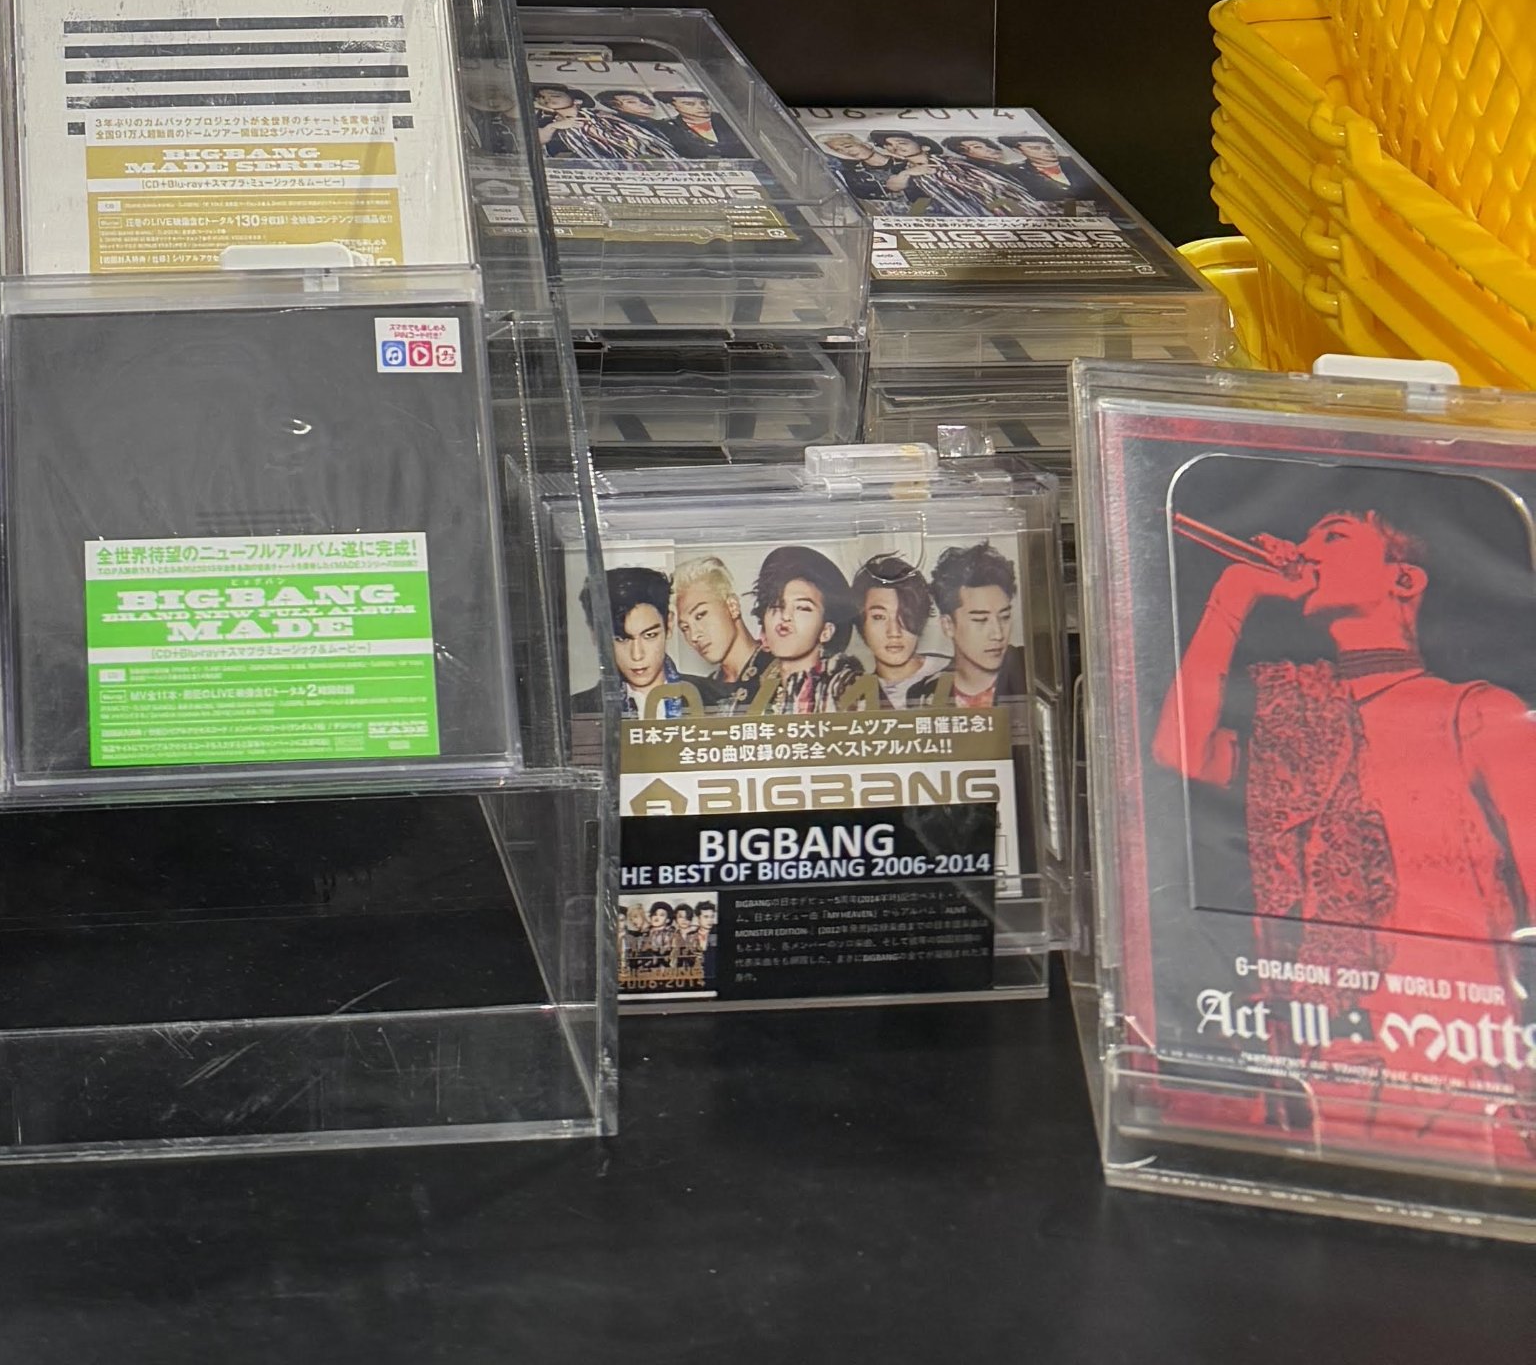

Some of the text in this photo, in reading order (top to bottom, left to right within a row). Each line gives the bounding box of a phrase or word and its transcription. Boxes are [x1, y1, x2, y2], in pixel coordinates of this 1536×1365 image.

[124, 159, 361, 174] MADE SERIES
[163, 147, 321, 160] BIGBANG
[900, 230, 1125, 243] BIGBANG
[116, 583, 400, 611] BIGBANG
[167, 616, 354, 642] MADE
[628, 715, 995, 744] 日本デビュー5周年・5大ドームツアー開催記念!
[679, 739, 953, 765] 全50曲収録の完全ベストアルバム!!
[697, 768, 1001, 814] BIGBANG
[698, 823, 896, 864] BIGBANG
[620, 852, 991, 887] HE BEST OF BIGBANG 2006-2014
[1235, 956, 1506, 1006] G-DRAGON 2017 WORLD TOUR
[1196, 988, 1272, 1041] Act
